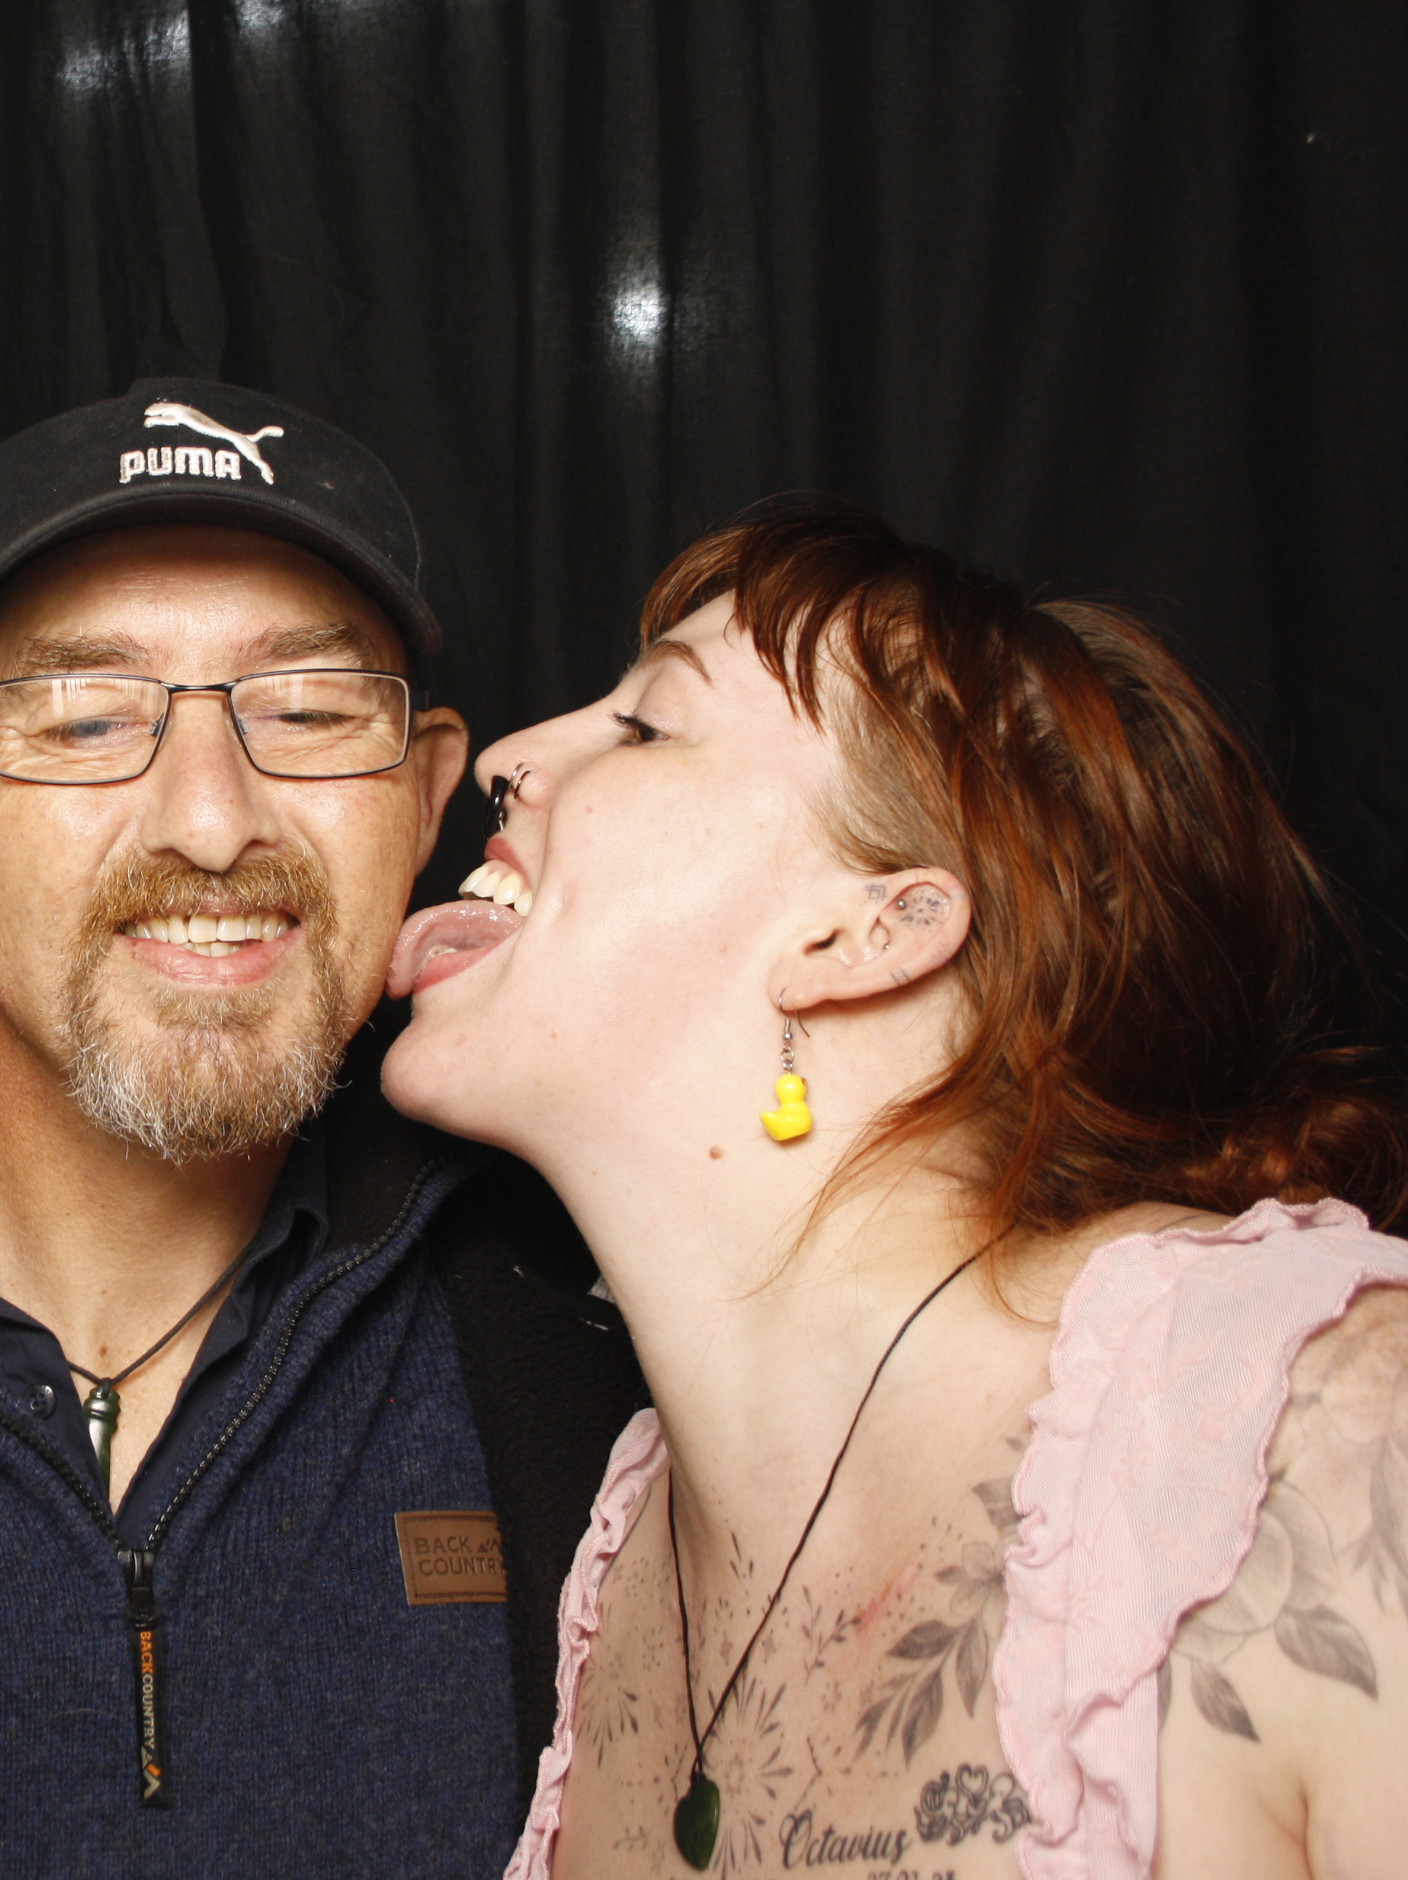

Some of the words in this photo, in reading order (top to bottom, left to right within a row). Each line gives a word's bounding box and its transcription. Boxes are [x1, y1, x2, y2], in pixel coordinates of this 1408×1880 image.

[119, 446, 242, 484] PUMA
[414, 1536, 473, 1555] BACK
[779, 1809, 912, 1870] Octavius
